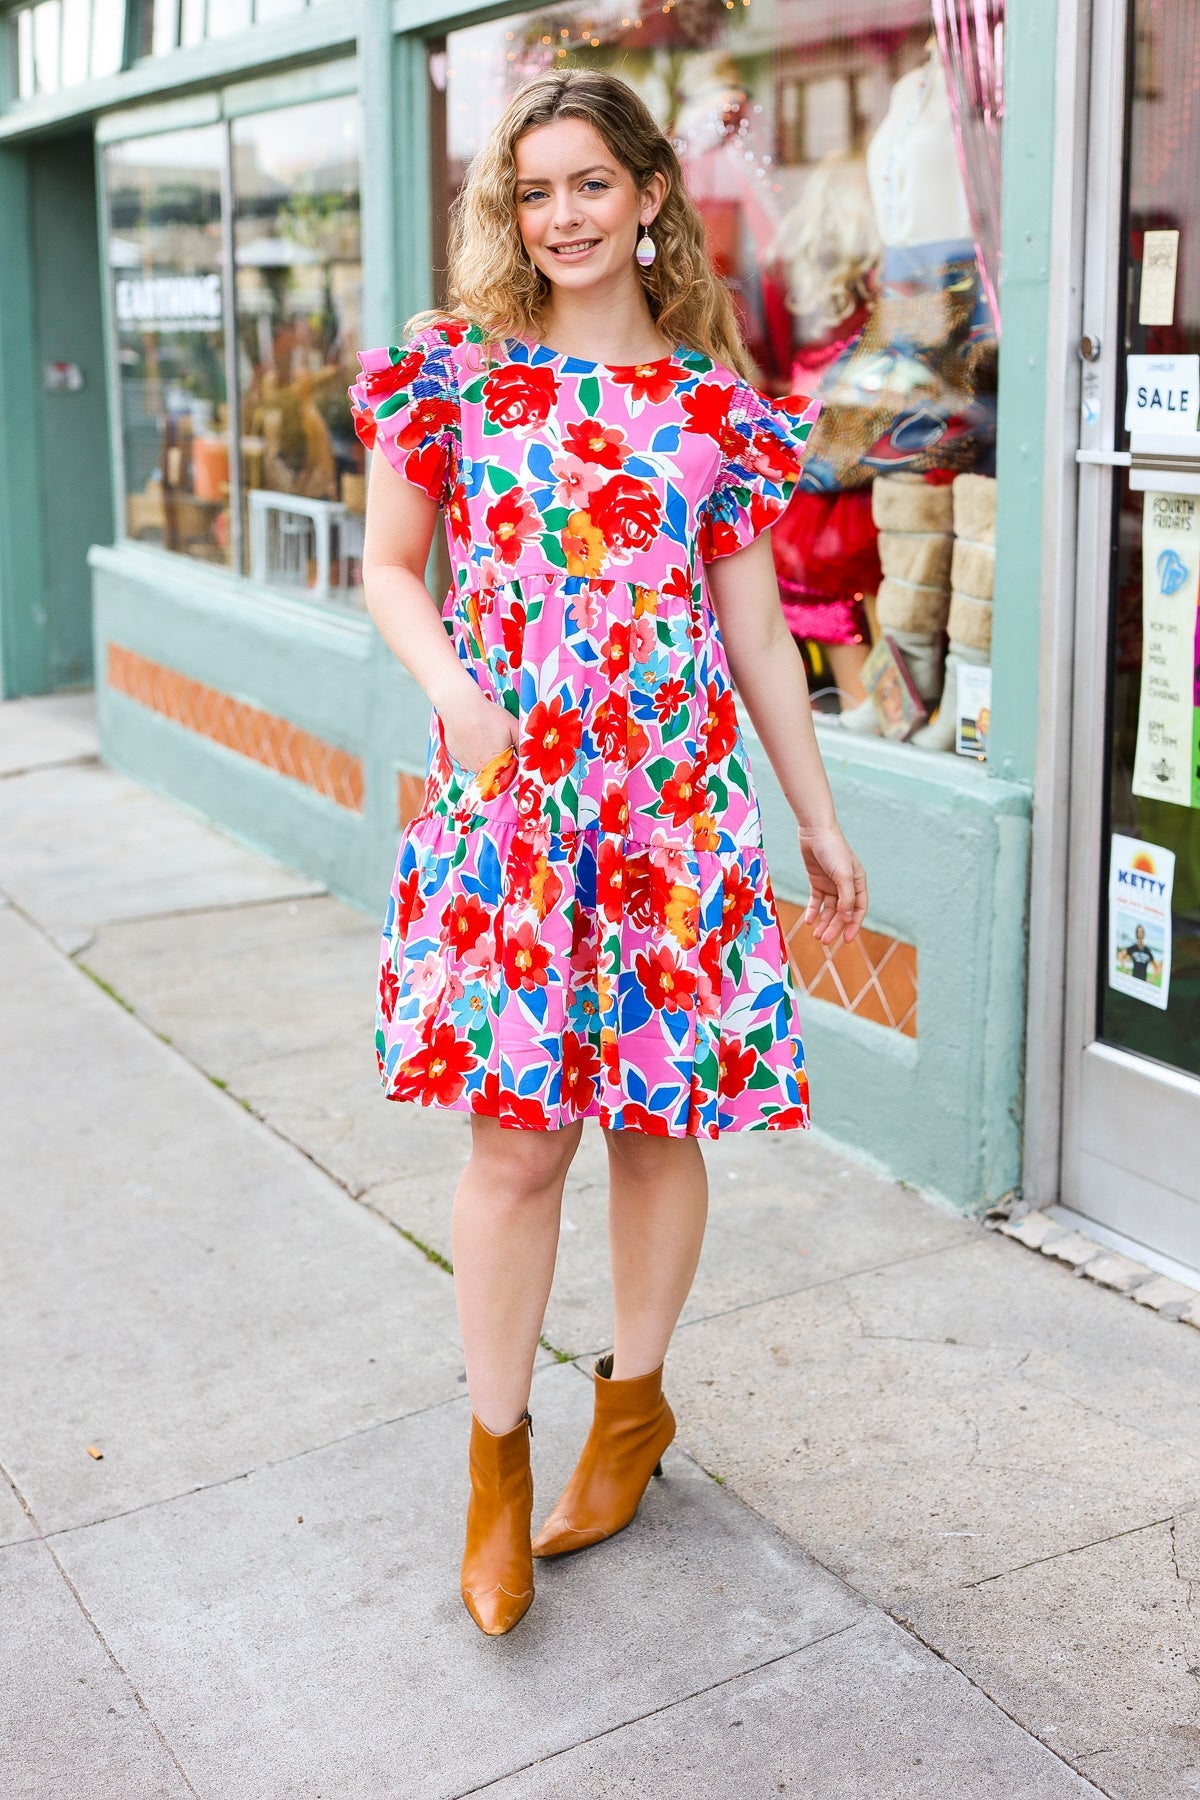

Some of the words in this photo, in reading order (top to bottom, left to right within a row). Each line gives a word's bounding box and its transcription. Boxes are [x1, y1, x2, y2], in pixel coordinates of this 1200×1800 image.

[1137, 386, 1189, 412] SALE
[1153, 497, 1195, 514] FOURTH
[1153, 514, 1192, 531] FRIDAYS
[1118, 869, 1166, 896] KETTY
